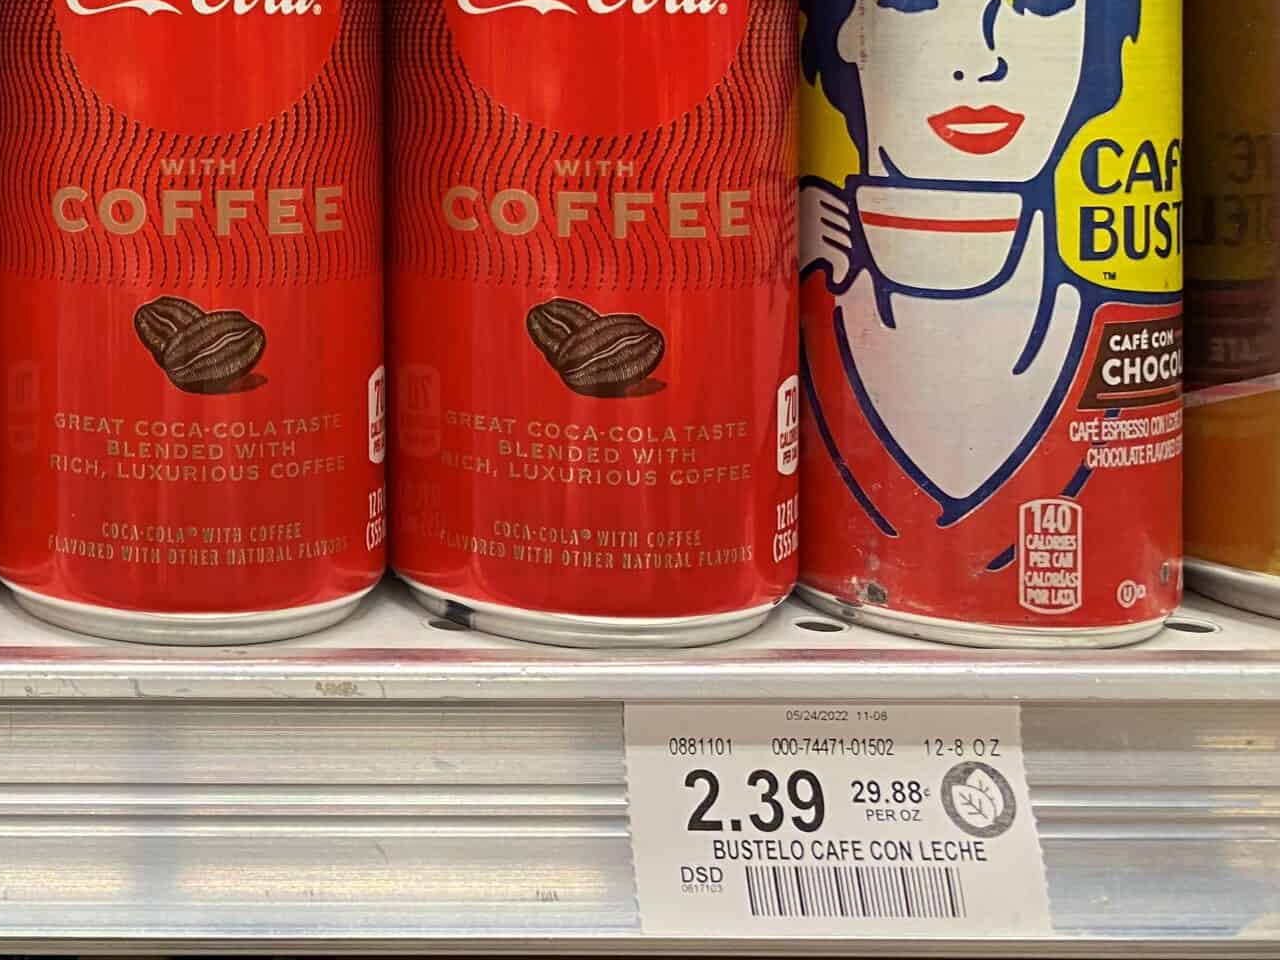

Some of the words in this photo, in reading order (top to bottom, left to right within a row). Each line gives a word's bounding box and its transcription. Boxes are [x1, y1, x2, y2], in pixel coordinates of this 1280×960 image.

[160, 158, 238, 177] WITH
[554, 160, 635, 177] WITH
[1079, 137, 1183, 196] CAF
[52, 186, 344, 237] COFFEE
[442, 186, 751, 239] COFFEE
[1079, 201, 1183, 262] BUST
[1109, 328, 1149, 352] CAFÉ
[1101, 351, 1183, 385] CHOCOL
[53, 412, 124, 436] GREAT
[134, 419, 276, 439] COCA-COLA
[282, 414, 344, 435] TASTE
[445, 411, 518, 434] GREAT
[527, 421, 676, 442] COCA-COLA
[684, 421, 748, 441] TASTE
[1070, 416, 1100, 442] CAFÉ
[107, 440, 225, 461] BLENDED
[236, 440, 297, 458] WITH
[498, 441, 620, 464] BLENDED
[632, 447, 697, 465] WITH
[49, 455, 108, 479] RICH,
[116, 463, 260, 482] LUXURIOUS
[270, 455, 346, 479] COFFEE
[508, 464, 658, 486] LUXURIOUS
[669, 464, 752, 485] COFFEE
[1031, 503, 1071, 533] 140
[202, 526, 244, 544] WITH
[249, 522, 303, 542] COFFEE
[597, 529, 638, 547] WITH
[646, 529, 702, 547] COFFEE
[120, 546, 161, 564] WITH
[167, 548, 219, 567] OTHER
[226, 544, 293, 565] NATURAL
[511, 544, 554, 565] WITH
[561, 550, 614, 568] OTHER
[622, 550, 692, 569] NATURAL
[785, 710, 849, 722] 05/24/2022
[669, 737, 733, 756] 0881101
[771, 738, 895, 756] 000-74471-01502
[684, 768, 825, 833] 2.39
[866, 808, 897, 822] PER
[899, 808, 922, 822] OZ
[713, 840, 805, 860] BUSTELO
[811, 840, 864, 861] CAFE
[869, 840, 913, 861] CON
[921, 841, 988, 862] LECHE
[680, 866, 724, 883] DSD
